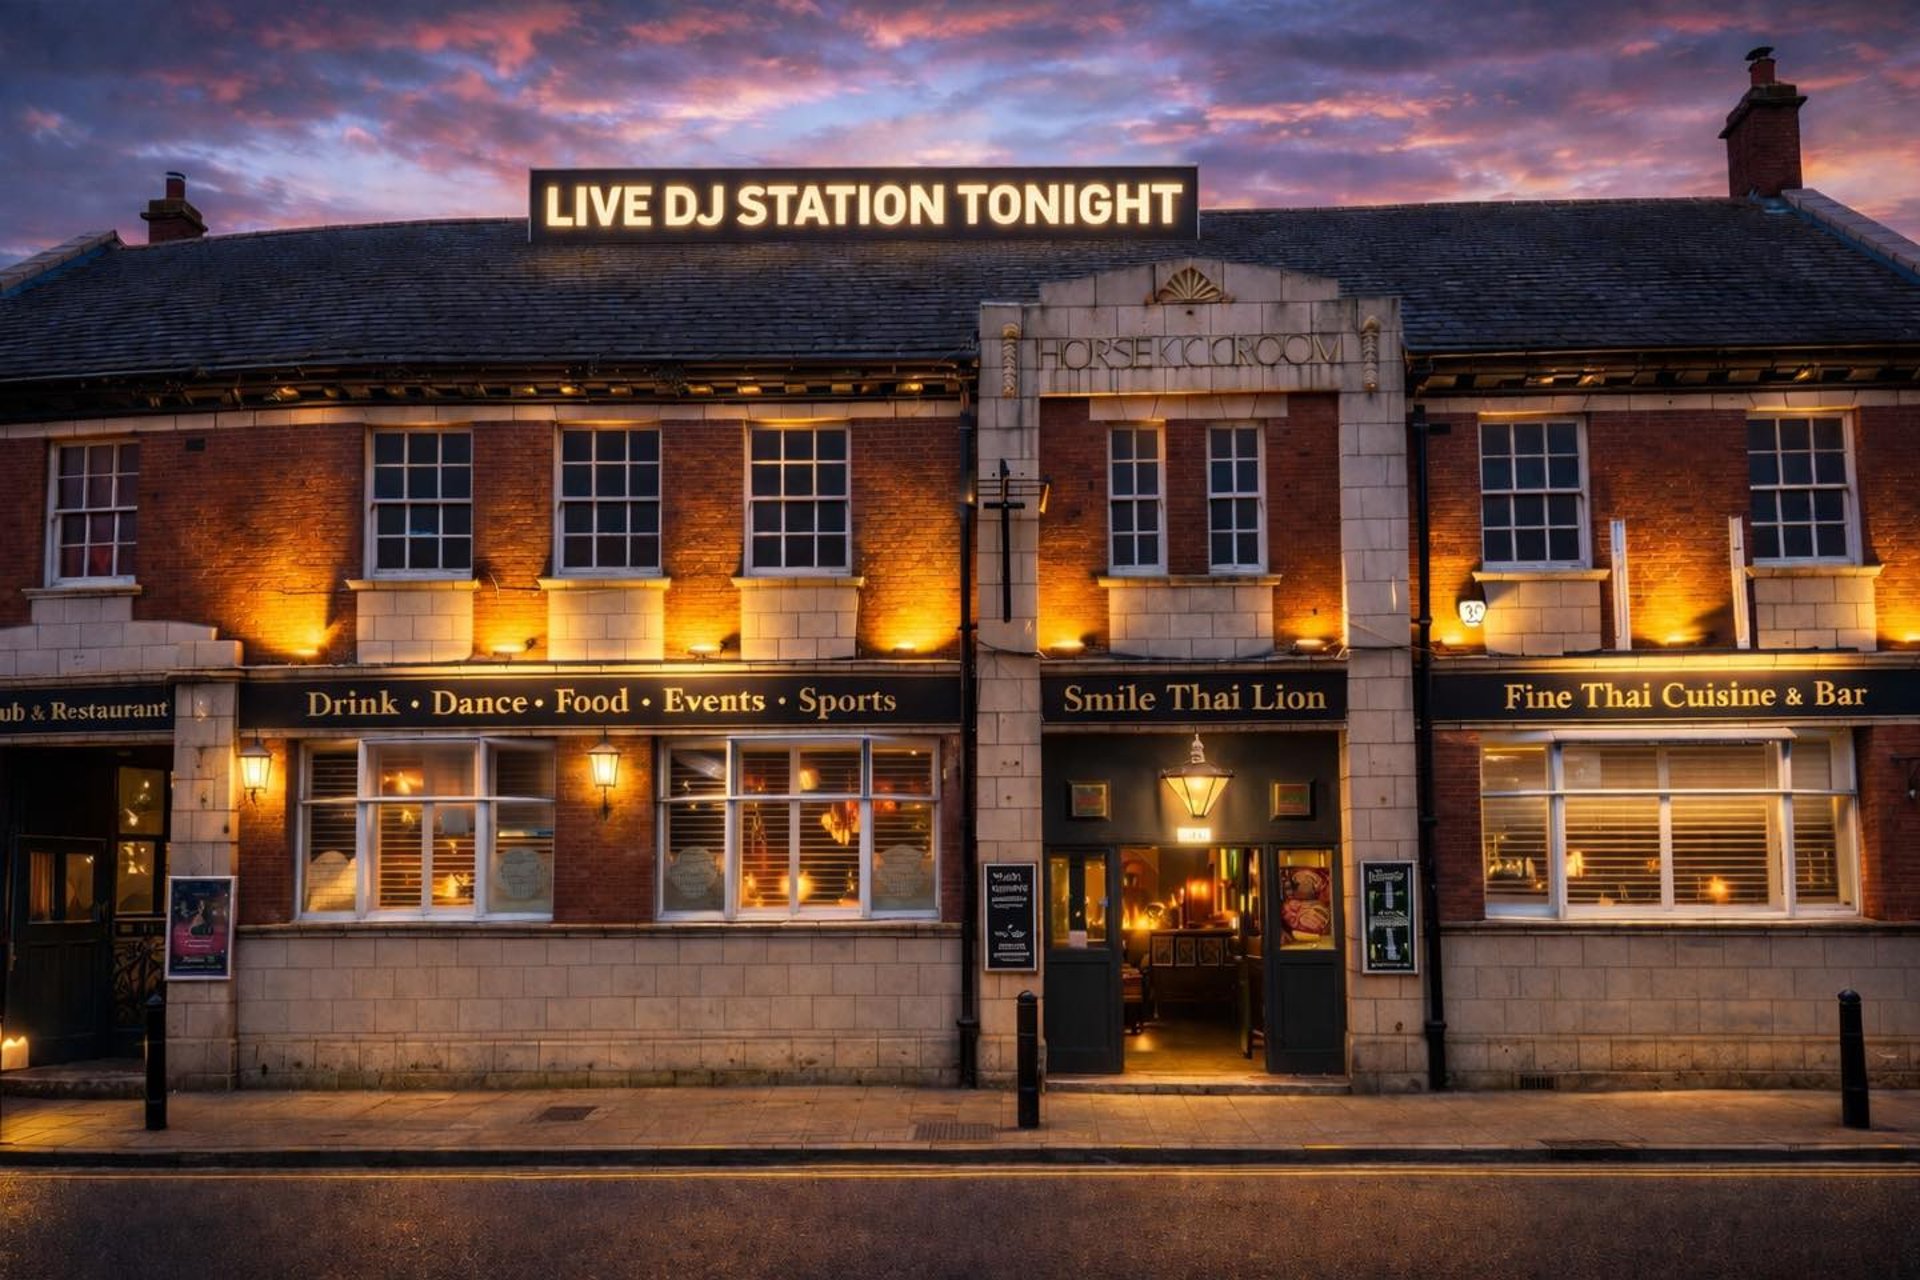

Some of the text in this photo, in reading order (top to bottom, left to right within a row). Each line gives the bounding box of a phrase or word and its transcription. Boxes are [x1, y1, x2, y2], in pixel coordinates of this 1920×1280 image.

[546, 183, 1183, 227] LIVE DJ STATION TONIGHT
[308, 687, 897, 720] Drink Dance Food Events Sports
[1064, 683, 1326, 711] Smile Thai Lion
[1505, 680, 1867, 709] Fine Thai Cuisine & Bar
[0, 701, 168, 722] ub & Restaurant
